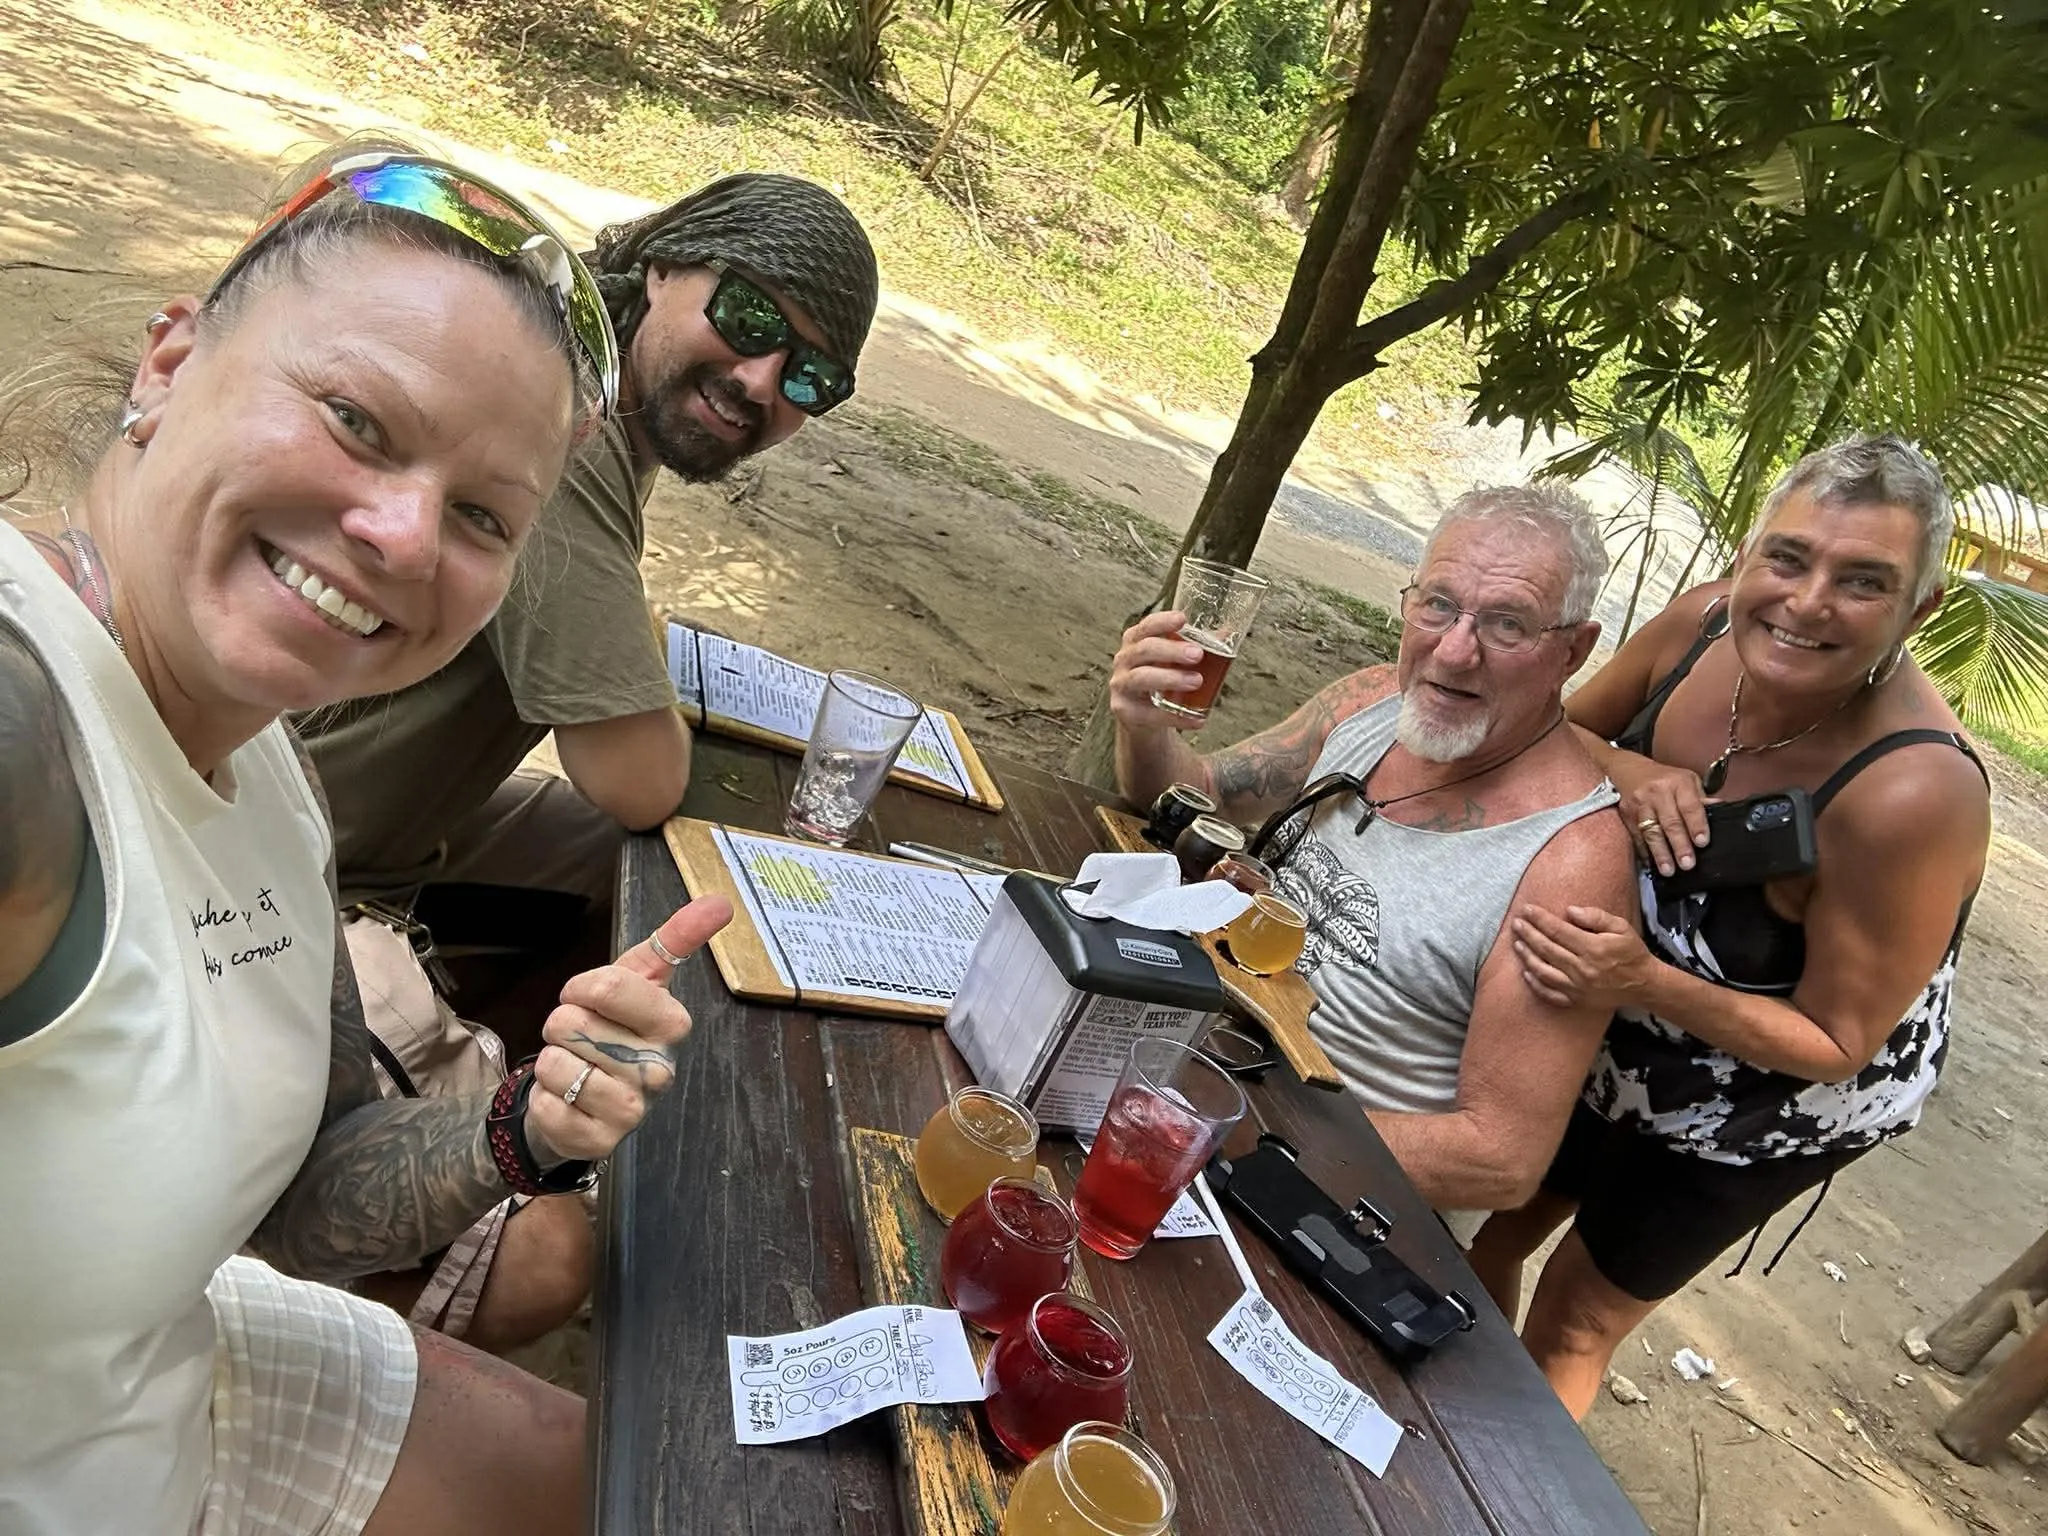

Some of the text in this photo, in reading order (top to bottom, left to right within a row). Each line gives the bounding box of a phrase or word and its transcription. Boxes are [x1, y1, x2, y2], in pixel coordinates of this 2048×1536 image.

[1145, 1011, 1168, 1021] HEY
[1167, 1011, 1192, 1021] YOU!
[1143, 1021, 1166, 1029] YEAH
[805, 1336, 837, 1351] Pours
